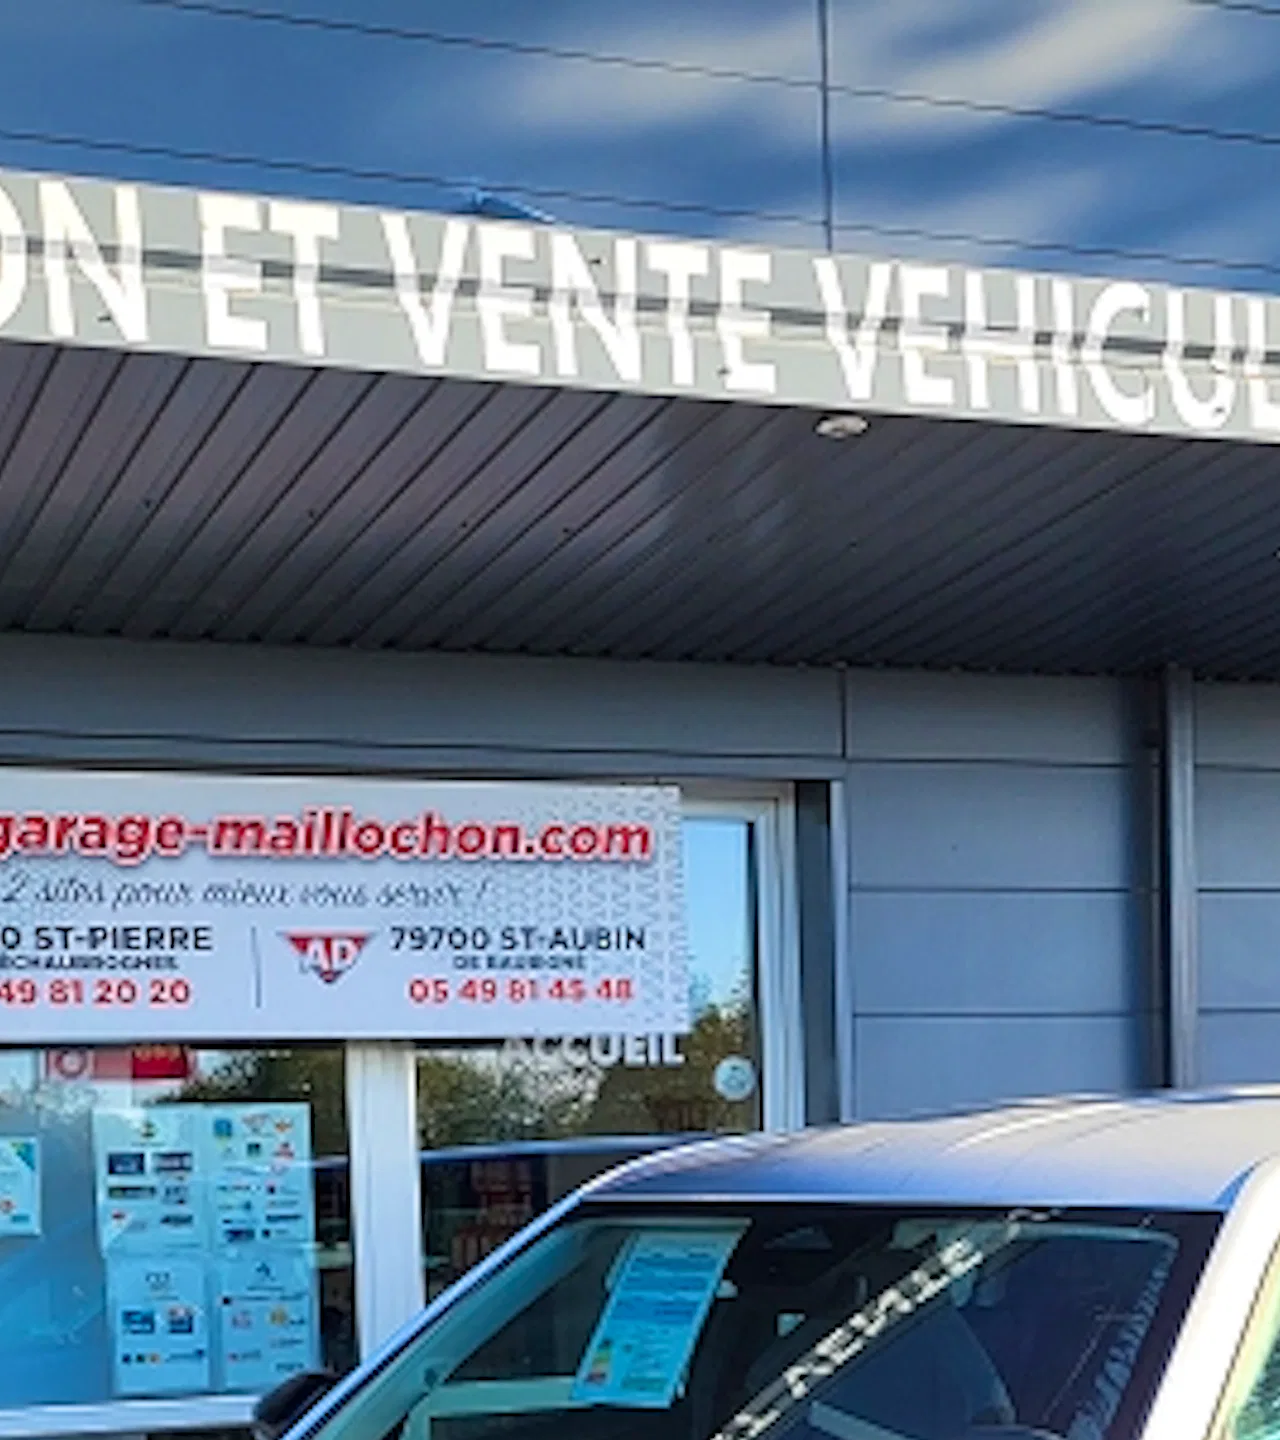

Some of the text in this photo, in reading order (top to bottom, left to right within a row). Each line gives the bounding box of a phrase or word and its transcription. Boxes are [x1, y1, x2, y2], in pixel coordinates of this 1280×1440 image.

[198, 191, 340, 358] ET
[377, 211, 778, 395] VENTE
[34, 926, 213, 951] ST-PIERRE
[390, 926, 646, 951] 79700 ST-AUBIN
[49, 979, 84, 1005] 81
[94, 979, 138, 1005] 20
[149, 979, 191, 1005] 20
[408, 978, 448, 1002] 05
[458, 978, 497, 1002] 49
[508, 978, 538, 1002] 81
